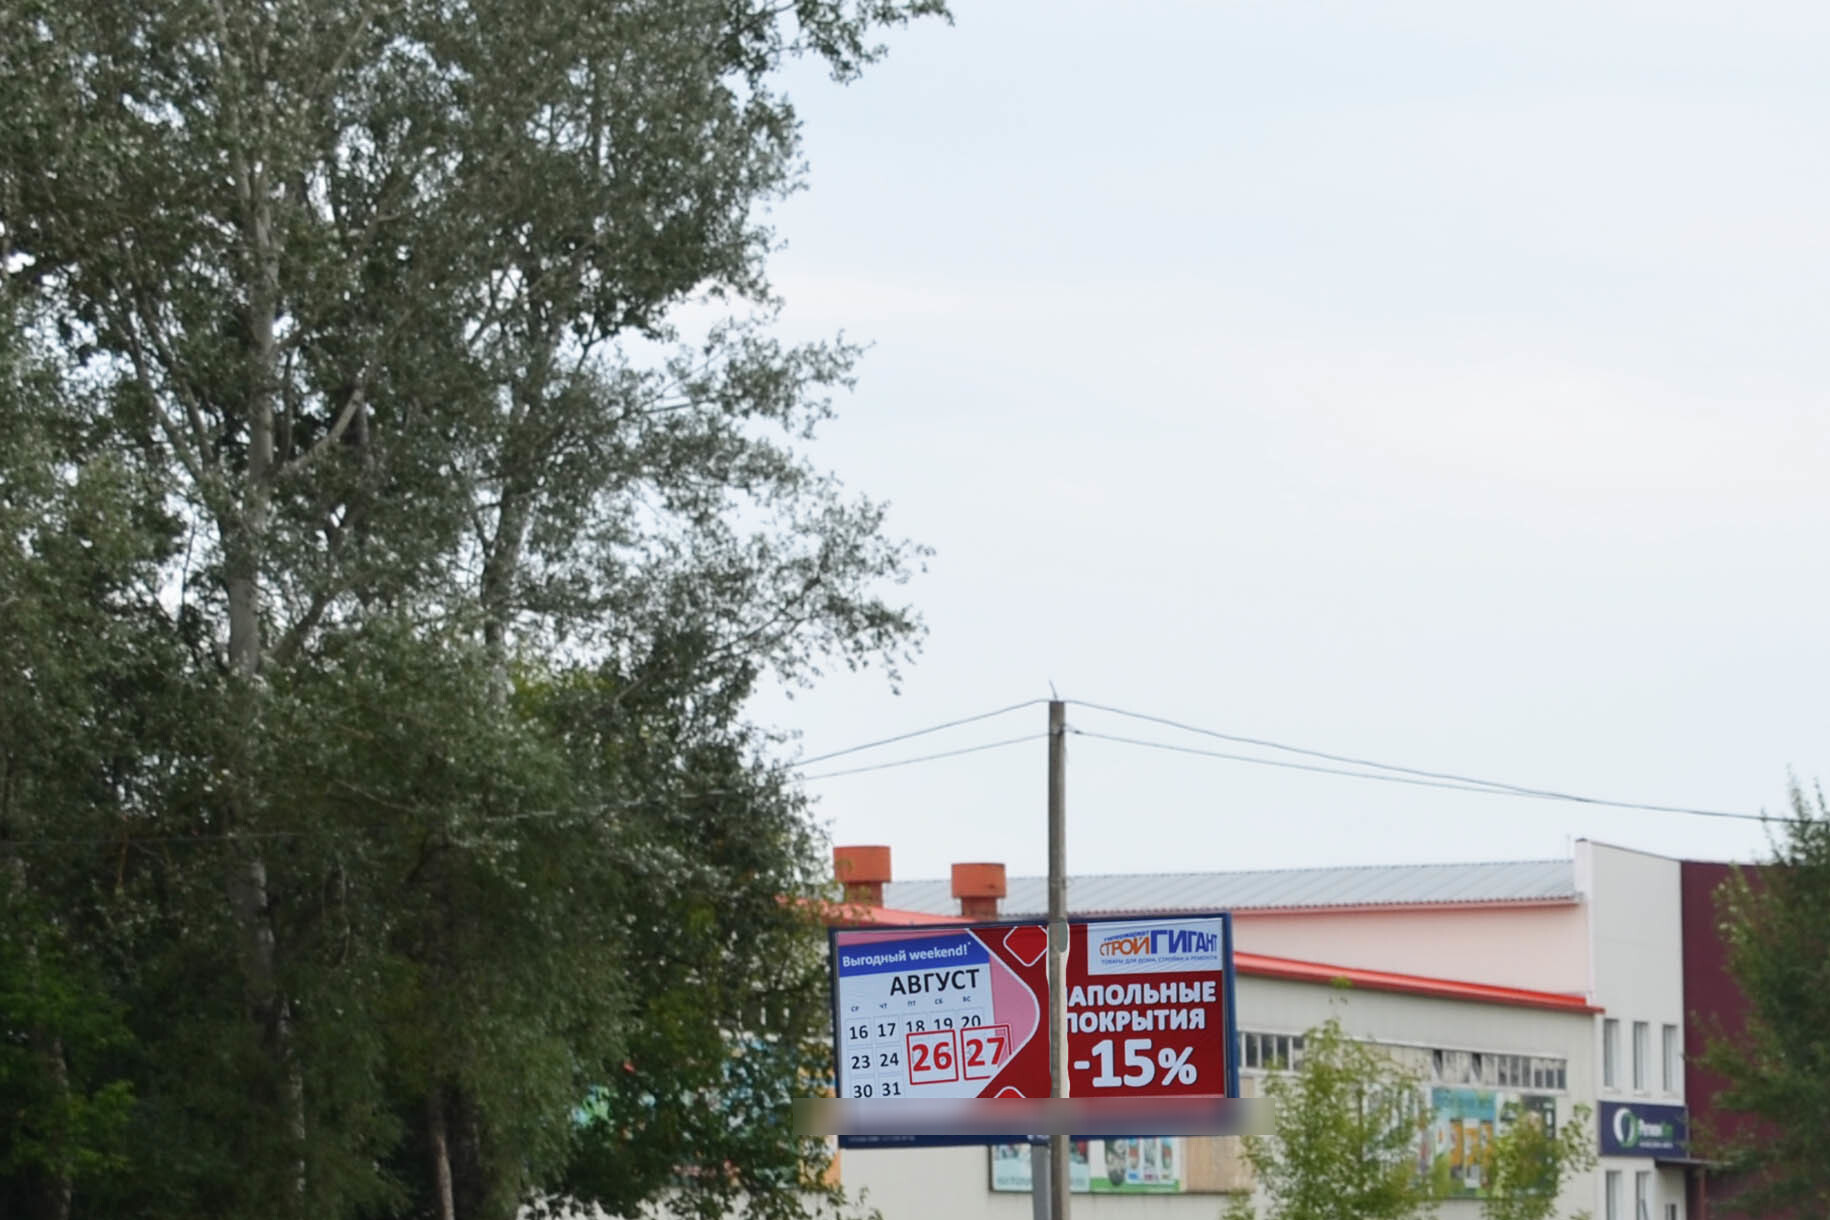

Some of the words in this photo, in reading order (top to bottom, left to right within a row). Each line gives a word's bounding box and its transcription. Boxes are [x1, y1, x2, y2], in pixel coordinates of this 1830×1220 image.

[842, 950, 907, 968] Выгодный
[890, 968, 980, 996] АВГУСТ
[1066, 981, 1216, 1007] АПОЛЬНЫЕ
[850, 1025, 869, 1040] 16
[877, 1022, 896, 1038] 17
[906, 1020, 925, 1033] 18
[934, 1017, 953, 1031] 19
[961, 1015, 981, 1028] 20
[1067, 1008, 1205, 1033] ПОКРЫТИЯ
[851, 1055, 871, 1070] 23
[879, 1052, 899, 1067] 24
[911, 1041, 953, 1073] 26
[966, 1036, 1005, 1068] 27
[1073, 1038, 1198, 1088] -15%
[853, 1084, 873, 1098] 30
[882, 1082, 901, 1097] 31
